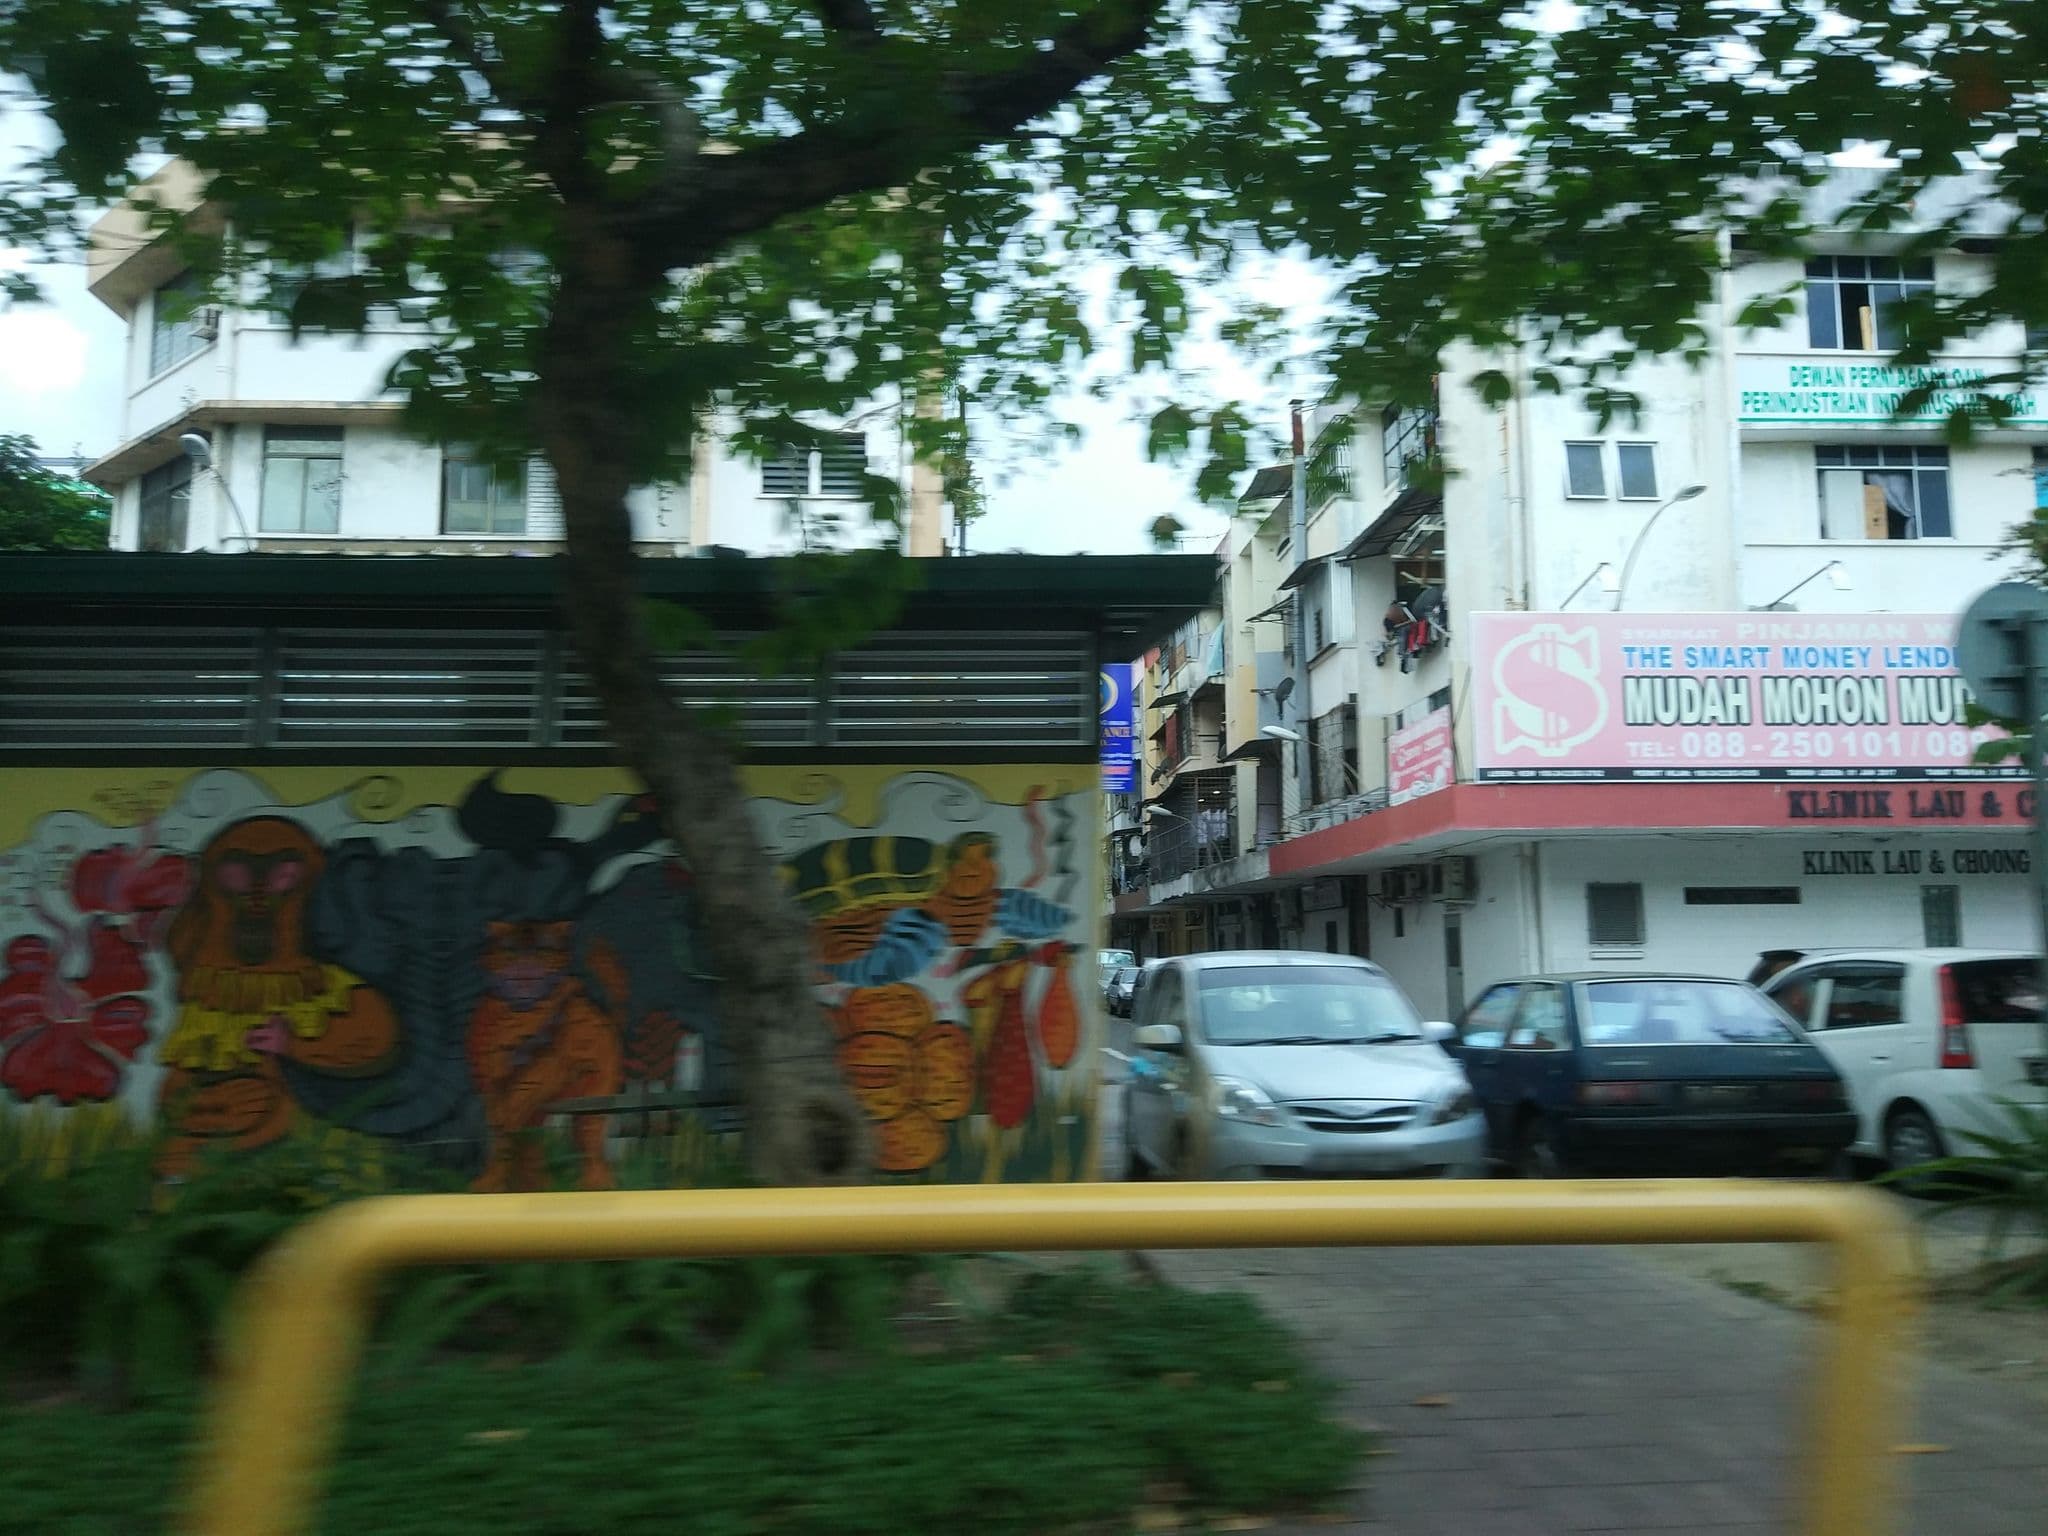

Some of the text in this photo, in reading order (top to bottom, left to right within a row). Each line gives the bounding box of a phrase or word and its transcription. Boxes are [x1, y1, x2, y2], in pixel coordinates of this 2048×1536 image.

[1736, 623, 1908, 641] PINJAMAN
[1622, 646, 1673, 669] THE
[1683, 646, 1770, 669] SMART
[1782, 646, 1872, 669] MONEY
[1623, 675, 1752, 726] MUDAH
[1761, 675, 1890, 726] MOHON
[1788, 790, 1893, 818] KLINIK
[1908, 790, 1966, 818] LAU
[1980, 790, 2003, 818] &
[1802, 849, 2031, 875] KLINIK LAU & CHOONG
